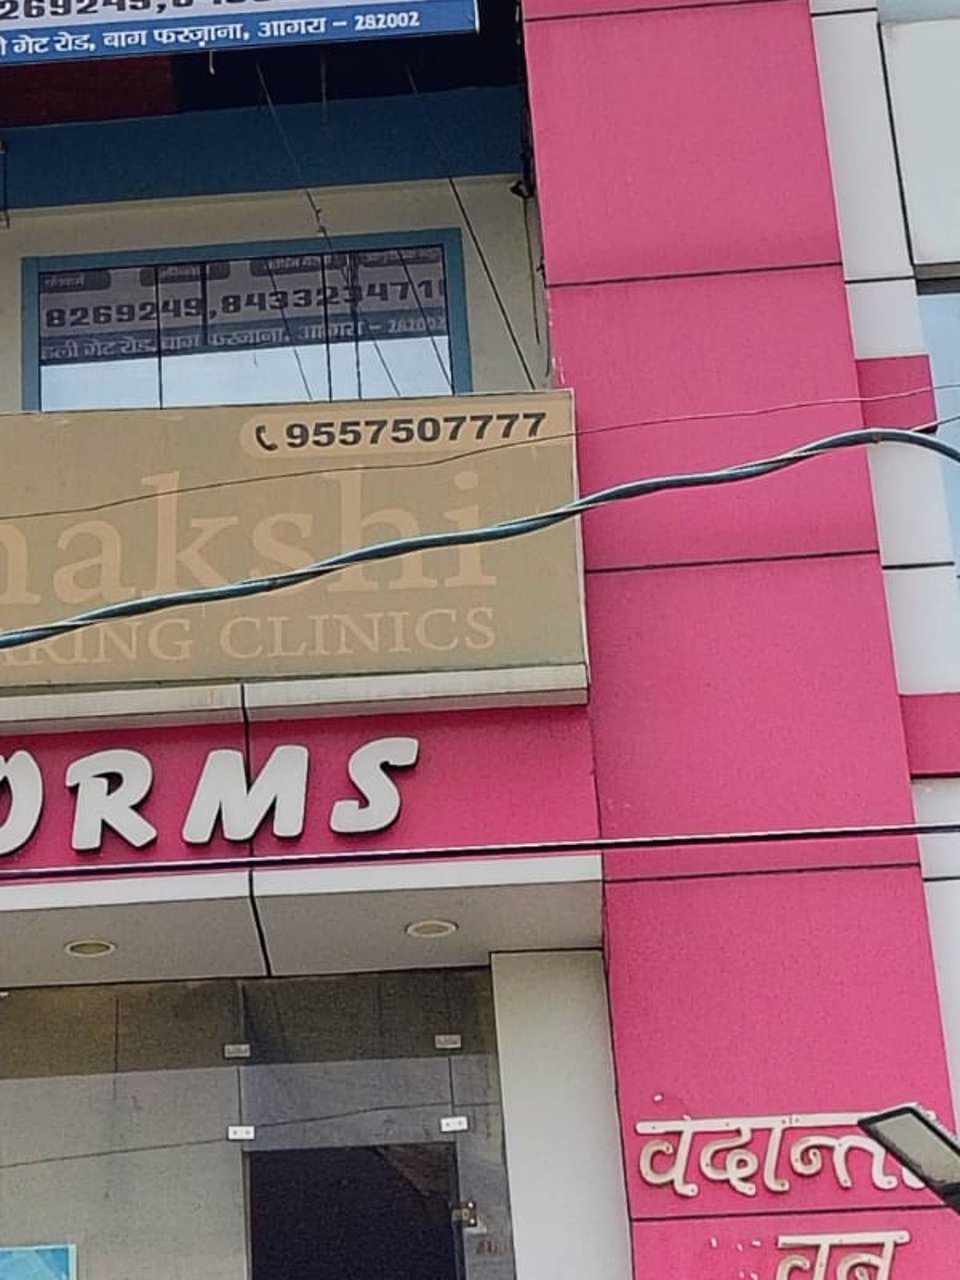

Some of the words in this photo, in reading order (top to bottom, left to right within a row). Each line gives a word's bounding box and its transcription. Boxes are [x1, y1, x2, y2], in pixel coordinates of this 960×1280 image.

[11, 32, 51, 54] गेट
[53, 31, 96, 53] रोड,
[257, 17, 327, 38] आगरा
[354, 11, 420, 31] 282002
[286, 411, 548, 449] 9557507777
[220, 606, 497, 660] CLINICS
